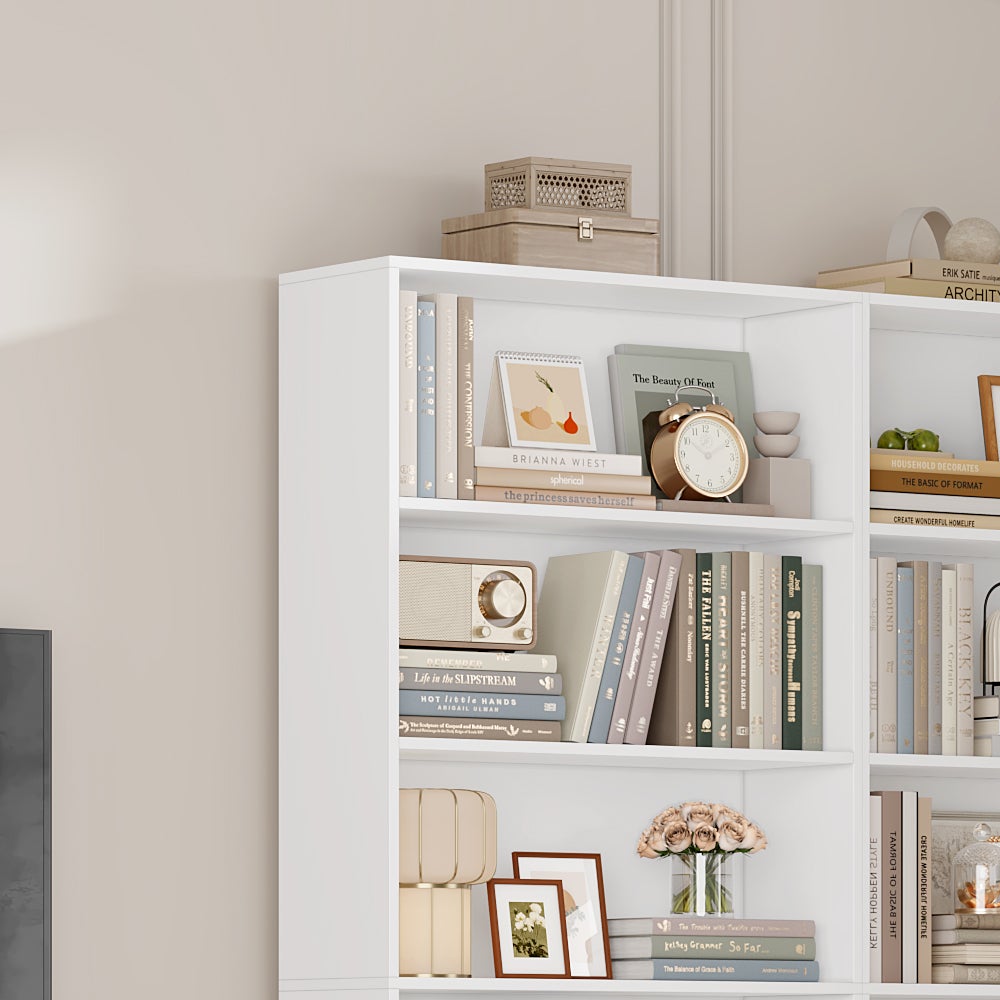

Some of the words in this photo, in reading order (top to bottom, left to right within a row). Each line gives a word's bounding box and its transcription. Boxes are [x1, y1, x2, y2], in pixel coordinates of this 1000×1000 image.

[942, 268, 959, 278] ERIK
[960, 269, 980, 279] SATIE
[982, 275, 1000, 283] musique
[633, 374, 650, 384] The
[652, 375, 682, 388] Beauty
[684, 378, 694, 386] Of
[697, 379, 715, 388] Font
[513, 454, 566, 465] BRIANNA
[572, 459, 607, 468] WIEST
[891, 459, 935, 470] HOUSEHOLD
[938, 461, 979, 473] DECORATES
[901, 478, 916, 486] THE
[918, 478, 939, 488] BASIC
[940, 480, 951, 489] OF
[953, 480, 983, 490] FORMAT
[893, 516, 914, 524] CREATE
[915, 517, 948, 526] WONDERFUL
[949, 519, 975, 528] HOMELIFE
[701, 570, 711, 594] THE
[886, 571, 894, 633] UNBOUND
[701, 597, 712, 641] FALLEN
[653, 629, 664, 652] THE
[959, 607, 971, 671] BLACK
[647, 653, 659, 687] AWARD
[414, 672, 430, 683] Life
[432, 673, 440, 683] in
[442, 674, 454, 684] the
[455, 674, 516, 686] SLIPSTREAM
[421, 695, 440, 704] HOT
[445, 695, 477, 704] little
[481, 697, 517, 706] HANDS
[959, 678, 971, 718] KEY
[690, 941, 723, 951] Grammer
[729, 941, 741, 953] So
